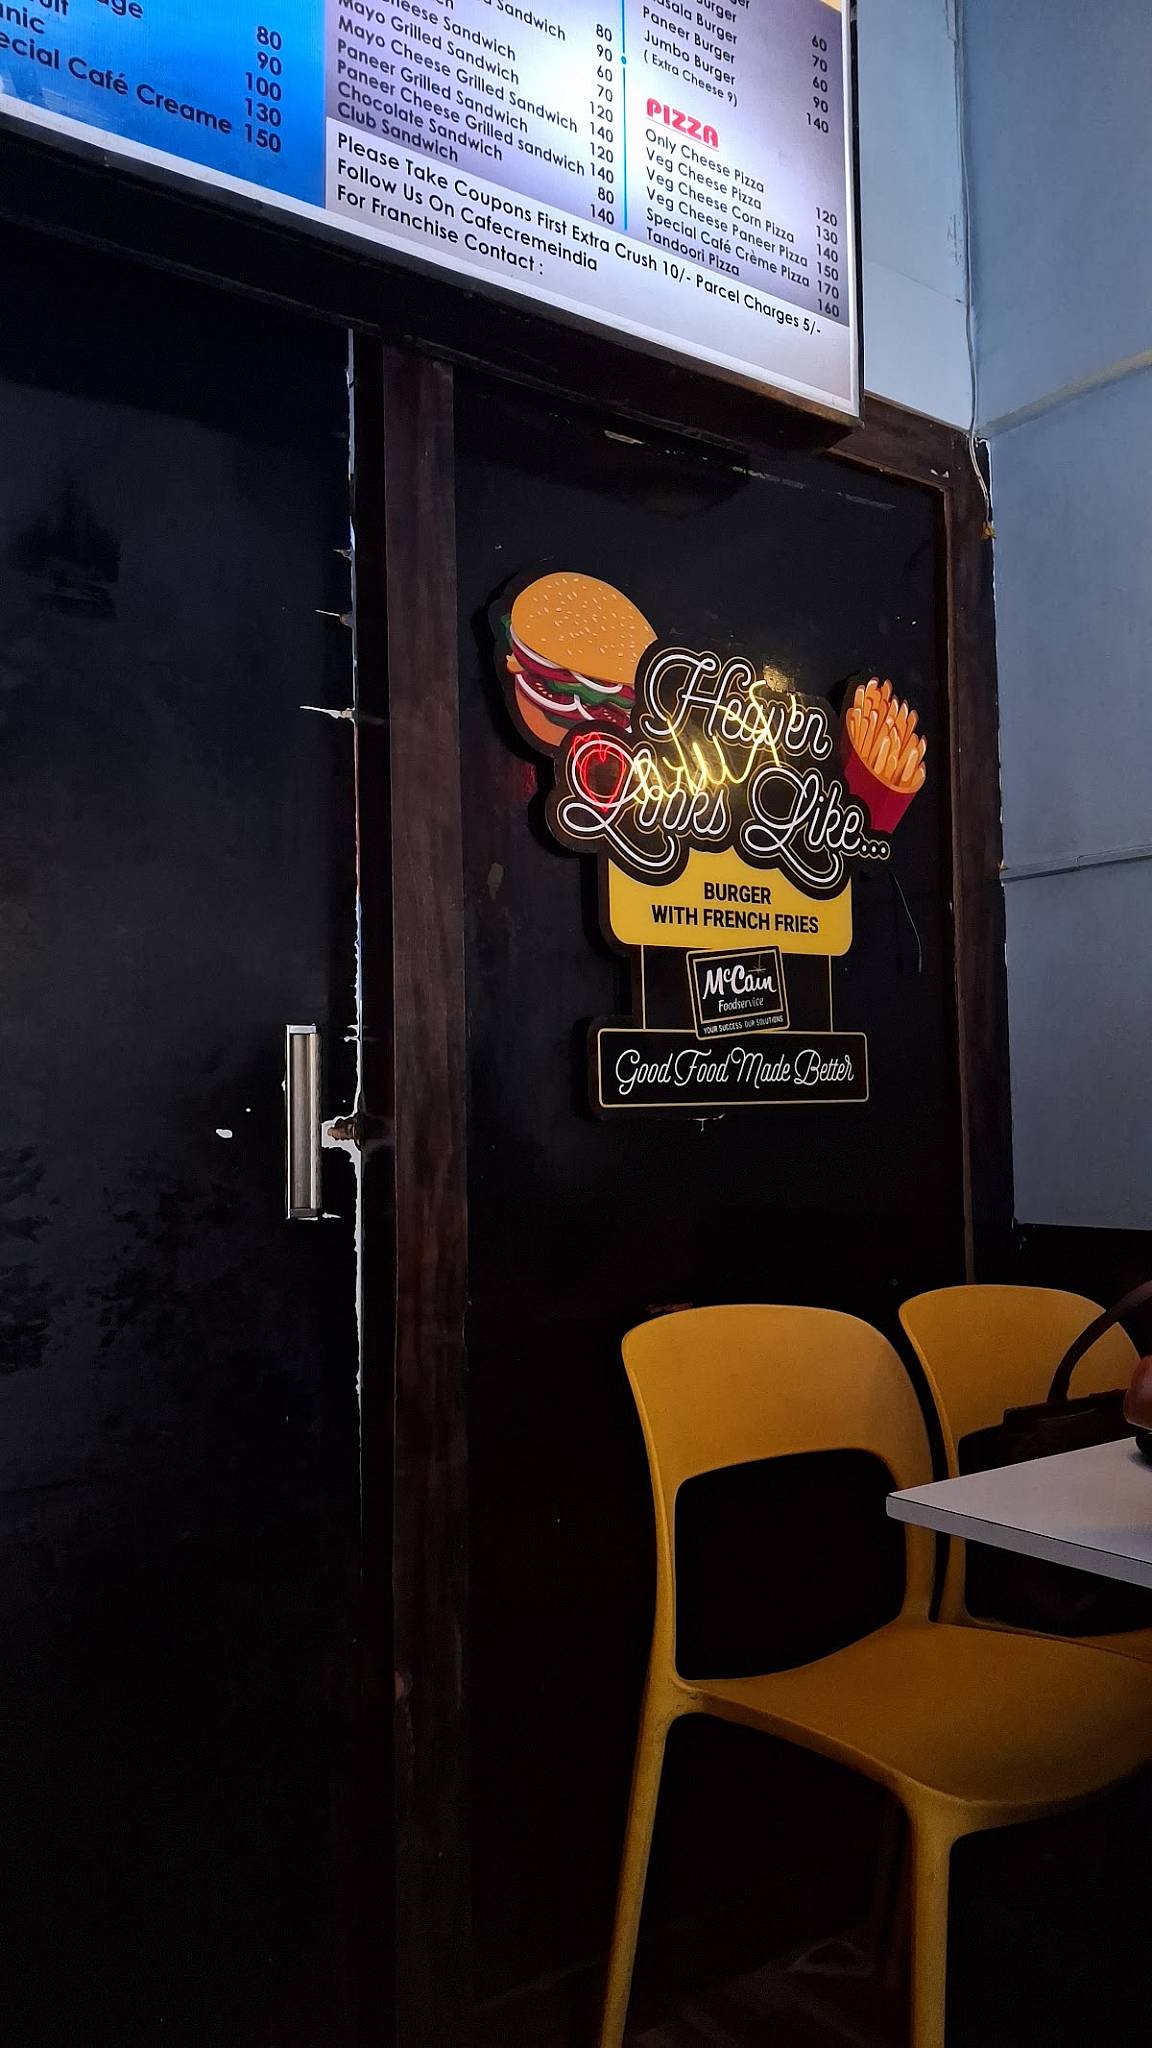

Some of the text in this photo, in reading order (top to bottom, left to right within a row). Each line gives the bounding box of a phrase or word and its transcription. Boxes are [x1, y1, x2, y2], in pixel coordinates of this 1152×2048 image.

[0, 3, 46, 34] nic
[497, 0, 566, 41] Sandwich
[596, 24, 613, 42] 80
[653, 0, 738, 45] asala Burger
[257, 26, 282, 50] 80
[443, 16, 516, 61] Sandwich
[643, 5, 735, 64] Paneer Burger
[812, 35, 828, 52] 60
[257, 51, 282, 76] 90
[391, 16, 442, 49] Grilled
[447, 40, 519, 85] Sandwich
[597, 44, 613, 62] 90
[644, 30, 736, 86] Jumbo Burger
[812, 55, 828, 73] 70
[245, 72, 282, 101] 100
[338, 15, 577, 133] Mayo Cheese Grilled Sandwich
[338, 38, 528, 133] Paneer Grilled Sandwich
[597, 65, 613, 82] 60
[682, 71, 724, 99] Cheese
[813, 76, 829, 93] 60
[68, 57, 128, 95] Café
[136, 84, 233, 134] Creame
[597, 84, 613, 102] 70
[814, 96, 829, 114] 90
[245, 97, 282, 127] 130
[338, 59, 585, 176] Paneer Cheese Grilled sandwich
[338, 81, 502, 161] Chocolate Sandwich
[590, 101, 613, 122] 120
[646, 97, 719, 149] PIZZA
[806, 113, 830, 134] 140
[245, 123, 281, 152] 150
[338, 102, 458, 162] Club Sandwich
[590, 121, 614, 143] 140
[590, 142, 614, 163] 120
[645, 128, 765, 193] Only Cheese Pizza
[590, 162, 614, 184] 140
[646, 147, 762, 210] Veg Cheese Pizza
[598, 186, 615, 204] 80
[646, 166, 795, 244] Veg Cheese Corn Pizza
[338, 158, 598, 271] Follow Us On Cafecremeindia
[338, 184, 366, 209] For
[372, 197, 459, 244] Franchise
[464, 233, 535, 271] Contact
[591, 203, 615, 225] 140
[646, 186, 809, 268] Veg Cheese Paneer Pizza
[815, 207, 838, 227] 120
[338, 132, 821, 336] Please Take Coupons First Extra Crush 10/- Parcel Charges 5/-
[646, 207, 810, 288] Special Café Crème Pizza
[816, 225, 839, 245] 130
[646, 227, 740, 277] Tandoori Pizza
[816, 243, 839, 263] 140
[817, 261, 840, 281] 150
[817, 279, 840, 299] 170
[817, 298, 840, 318] 160
[645, 653, 829, 755] Heaven
[562, 739, 728, 868] Looks
[704, 882, 772, 905] BURGER
[651, 905, 819, 933] WITH FRENCH FRIES
[702, 964, 777, 1000] McCain
[615, 1046, 855, 1095] Good Food Made Better
